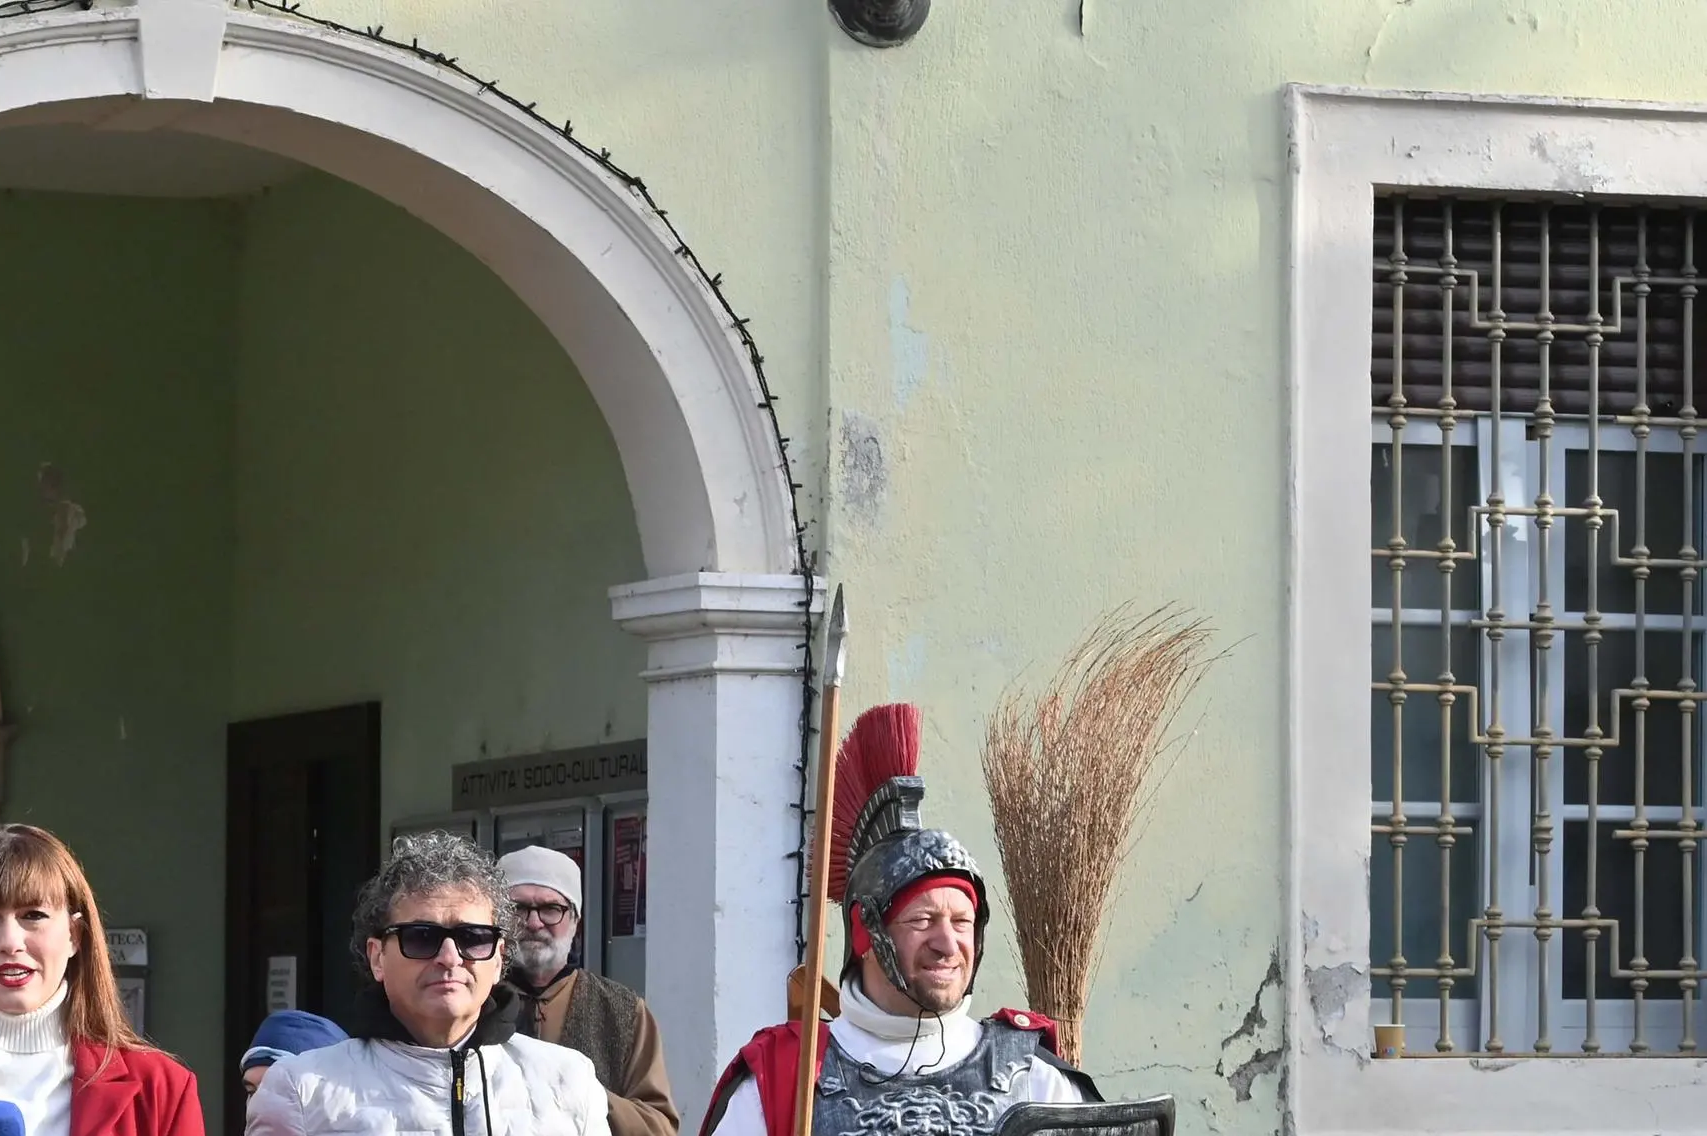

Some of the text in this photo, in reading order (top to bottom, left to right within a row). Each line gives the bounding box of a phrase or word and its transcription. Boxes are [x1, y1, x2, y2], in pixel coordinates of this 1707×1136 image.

[461, 751, 647, 796] ATTIVITA' SOCIO-CULTURAL
[107, 932, 145, 945] TECA
